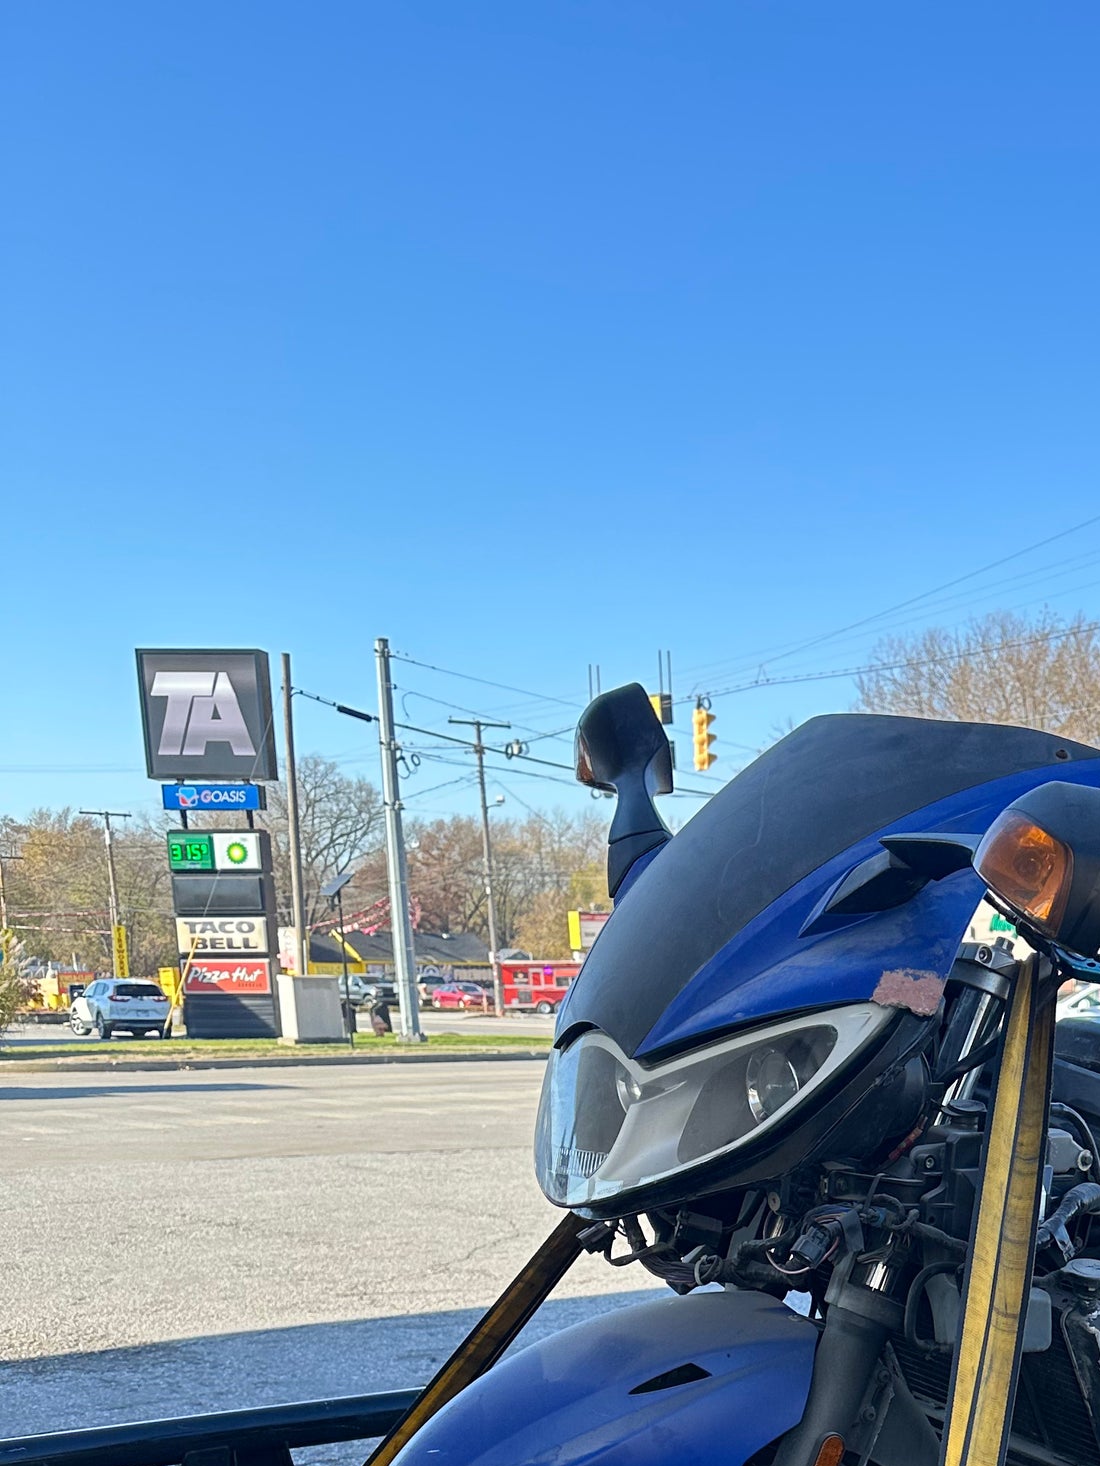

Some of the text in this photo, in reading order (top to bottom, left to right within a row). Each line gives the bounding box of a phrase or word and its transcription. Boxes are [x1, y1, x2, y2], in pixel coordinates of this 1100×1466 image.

[150, 671, 257, 756] TA
[201, 789, 246, 803] GOASIS
[184, 921, 256, 934] TACO
[190, 937, 258, 950] BELL
[187, 966, 264, 984] Pizza Hut
